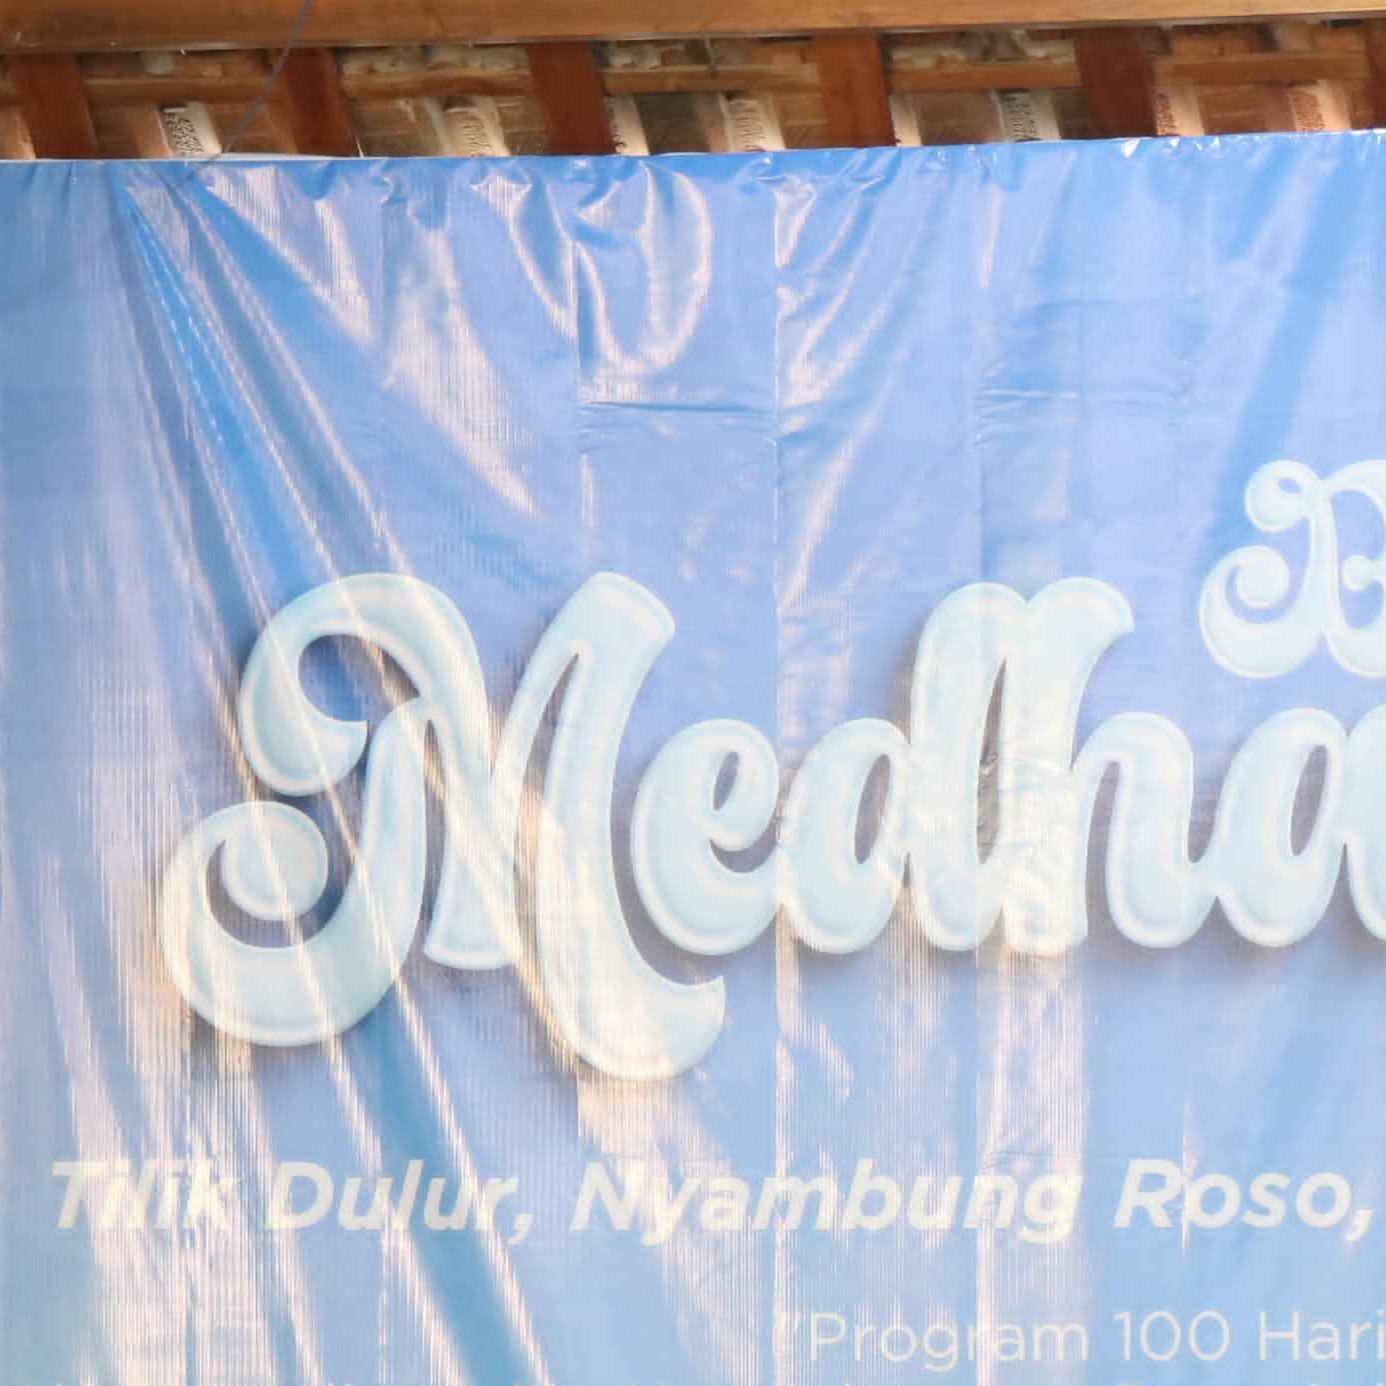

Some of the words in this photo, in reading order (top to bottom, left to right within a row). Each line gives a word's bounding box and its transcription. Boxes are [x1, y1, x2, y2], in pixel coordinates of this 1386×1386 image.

[51, 1158, 240, 1231] Tilik
[264, 1158, 534, 1244] Dulur,
[570, 1156, 1085, 1247] Nyambung
[1113, 1157, 1374, 1243] Roso,
[1113, 1310, 1232, 1362] 100
